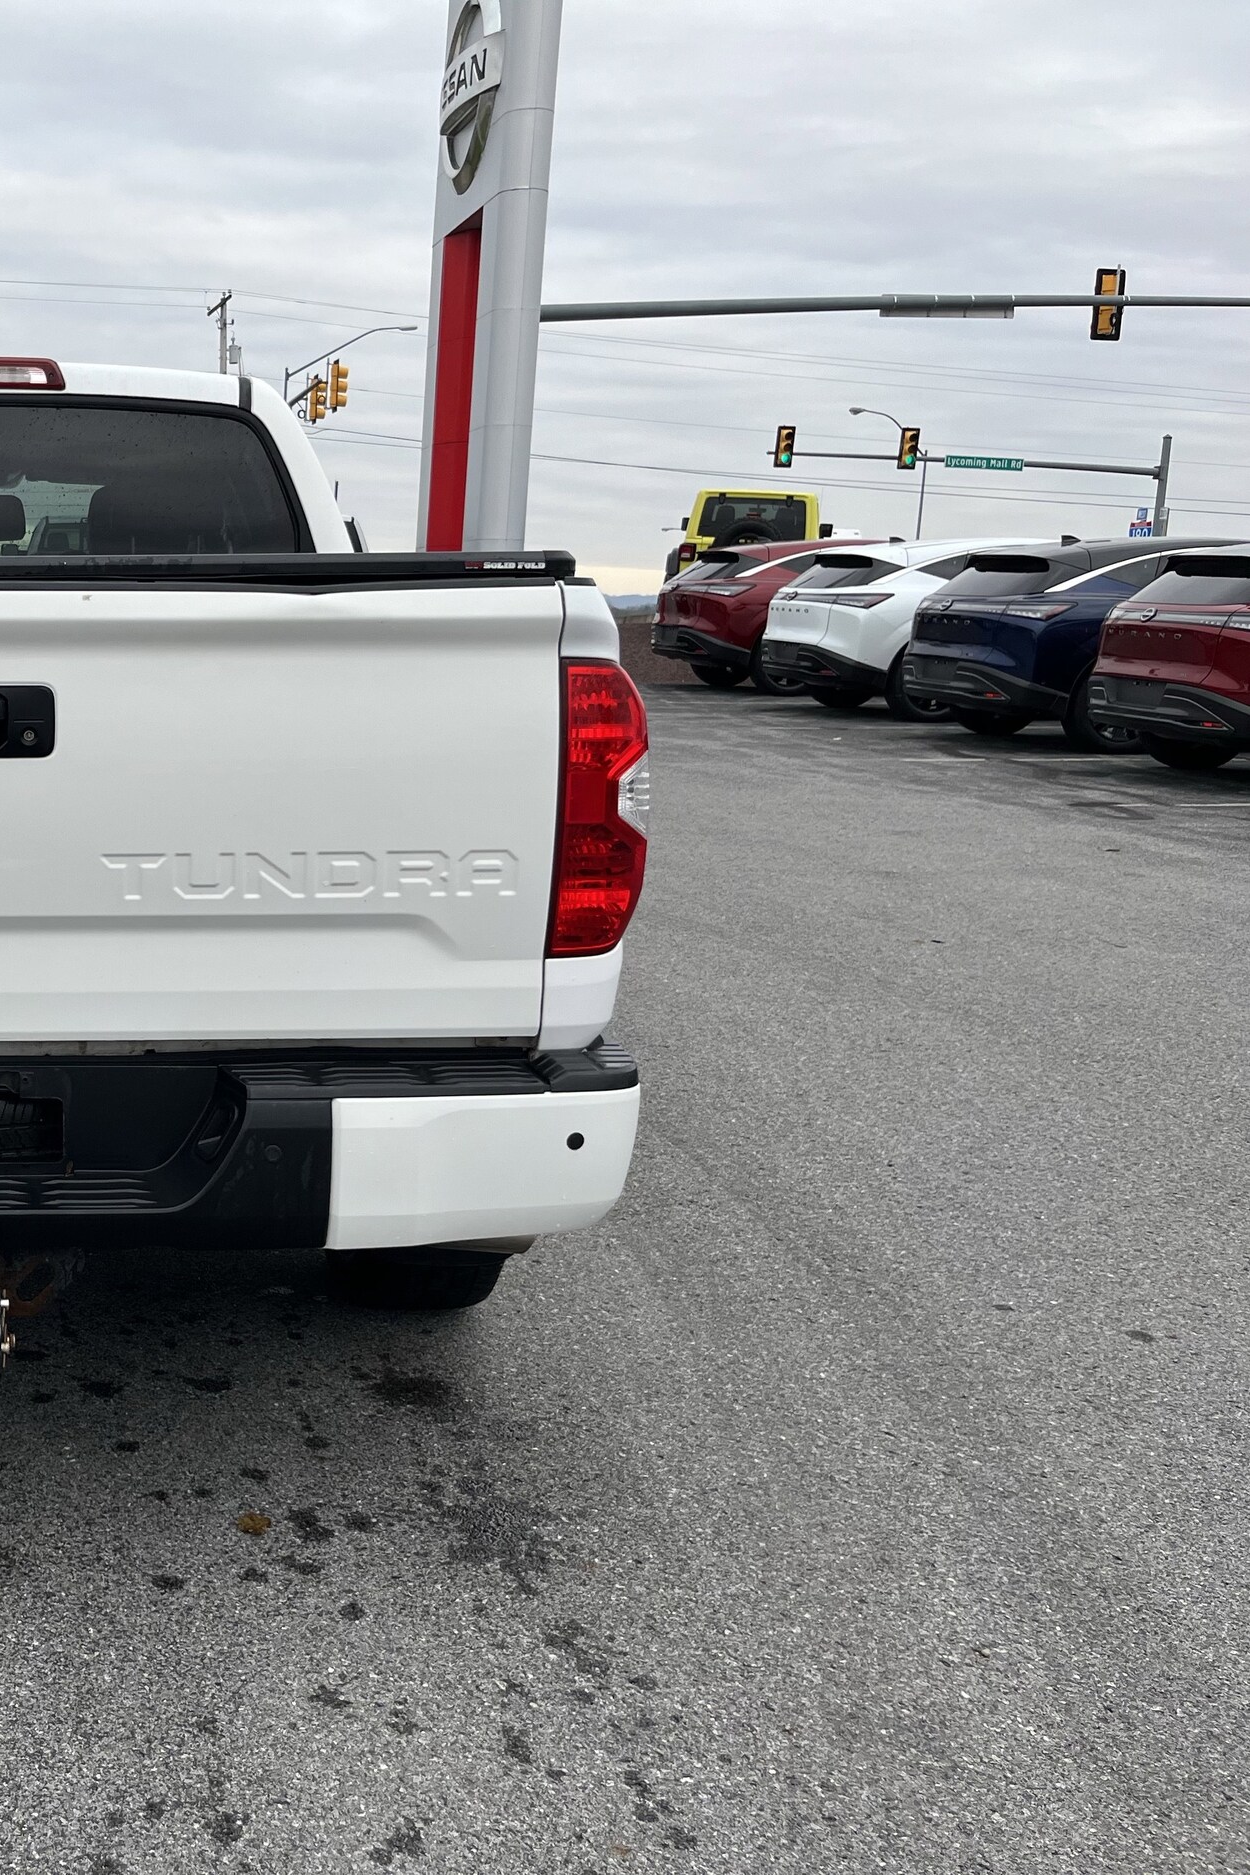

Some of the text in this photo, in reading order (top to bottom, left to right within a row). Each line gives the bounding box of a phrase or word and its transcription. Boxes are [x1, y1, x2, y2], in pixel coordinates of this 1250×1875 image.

[947, 457, 1022, 469] Lycoming Mall Rd
[101, 849, 519, 899] TUNDRA
